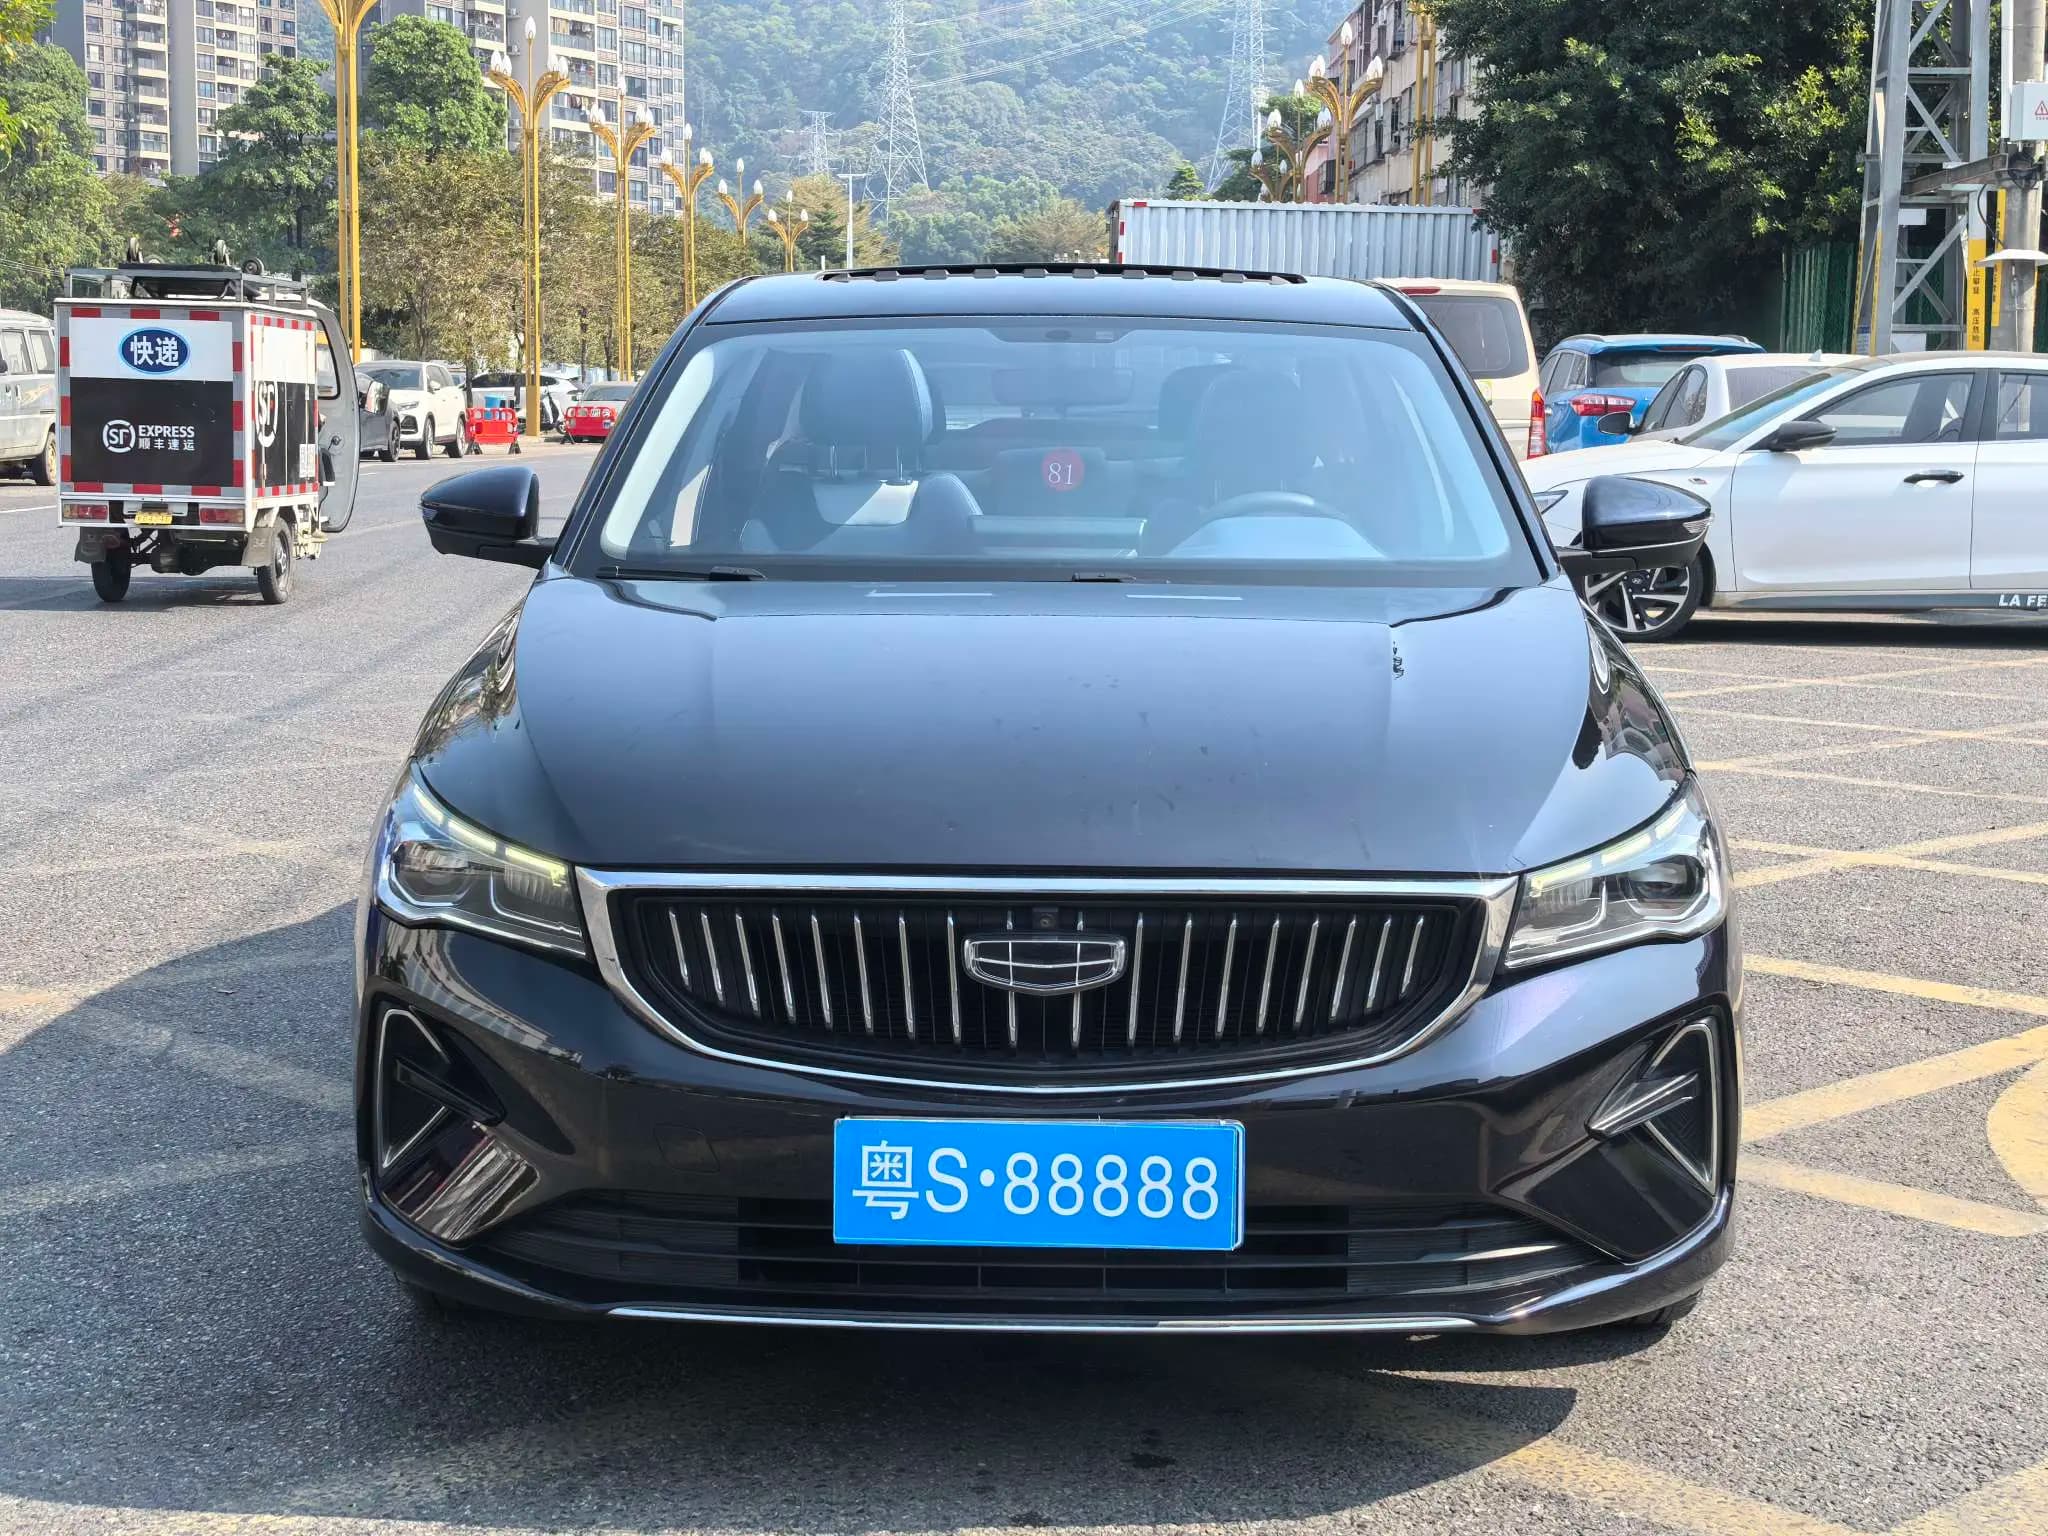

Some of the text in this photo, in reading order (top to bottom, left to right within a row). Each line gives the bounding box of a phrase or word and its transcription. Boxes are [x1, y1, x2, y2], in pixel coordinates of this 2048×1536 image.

[130, 335, 179, 367] 快递
[138, 425, 195, 438] EXPRESS
[1049, 462, 1073, 485] 81
[1999, 594, 2020, 607] LA
[852, 1140, 1219, 1221] 粤S·88888
